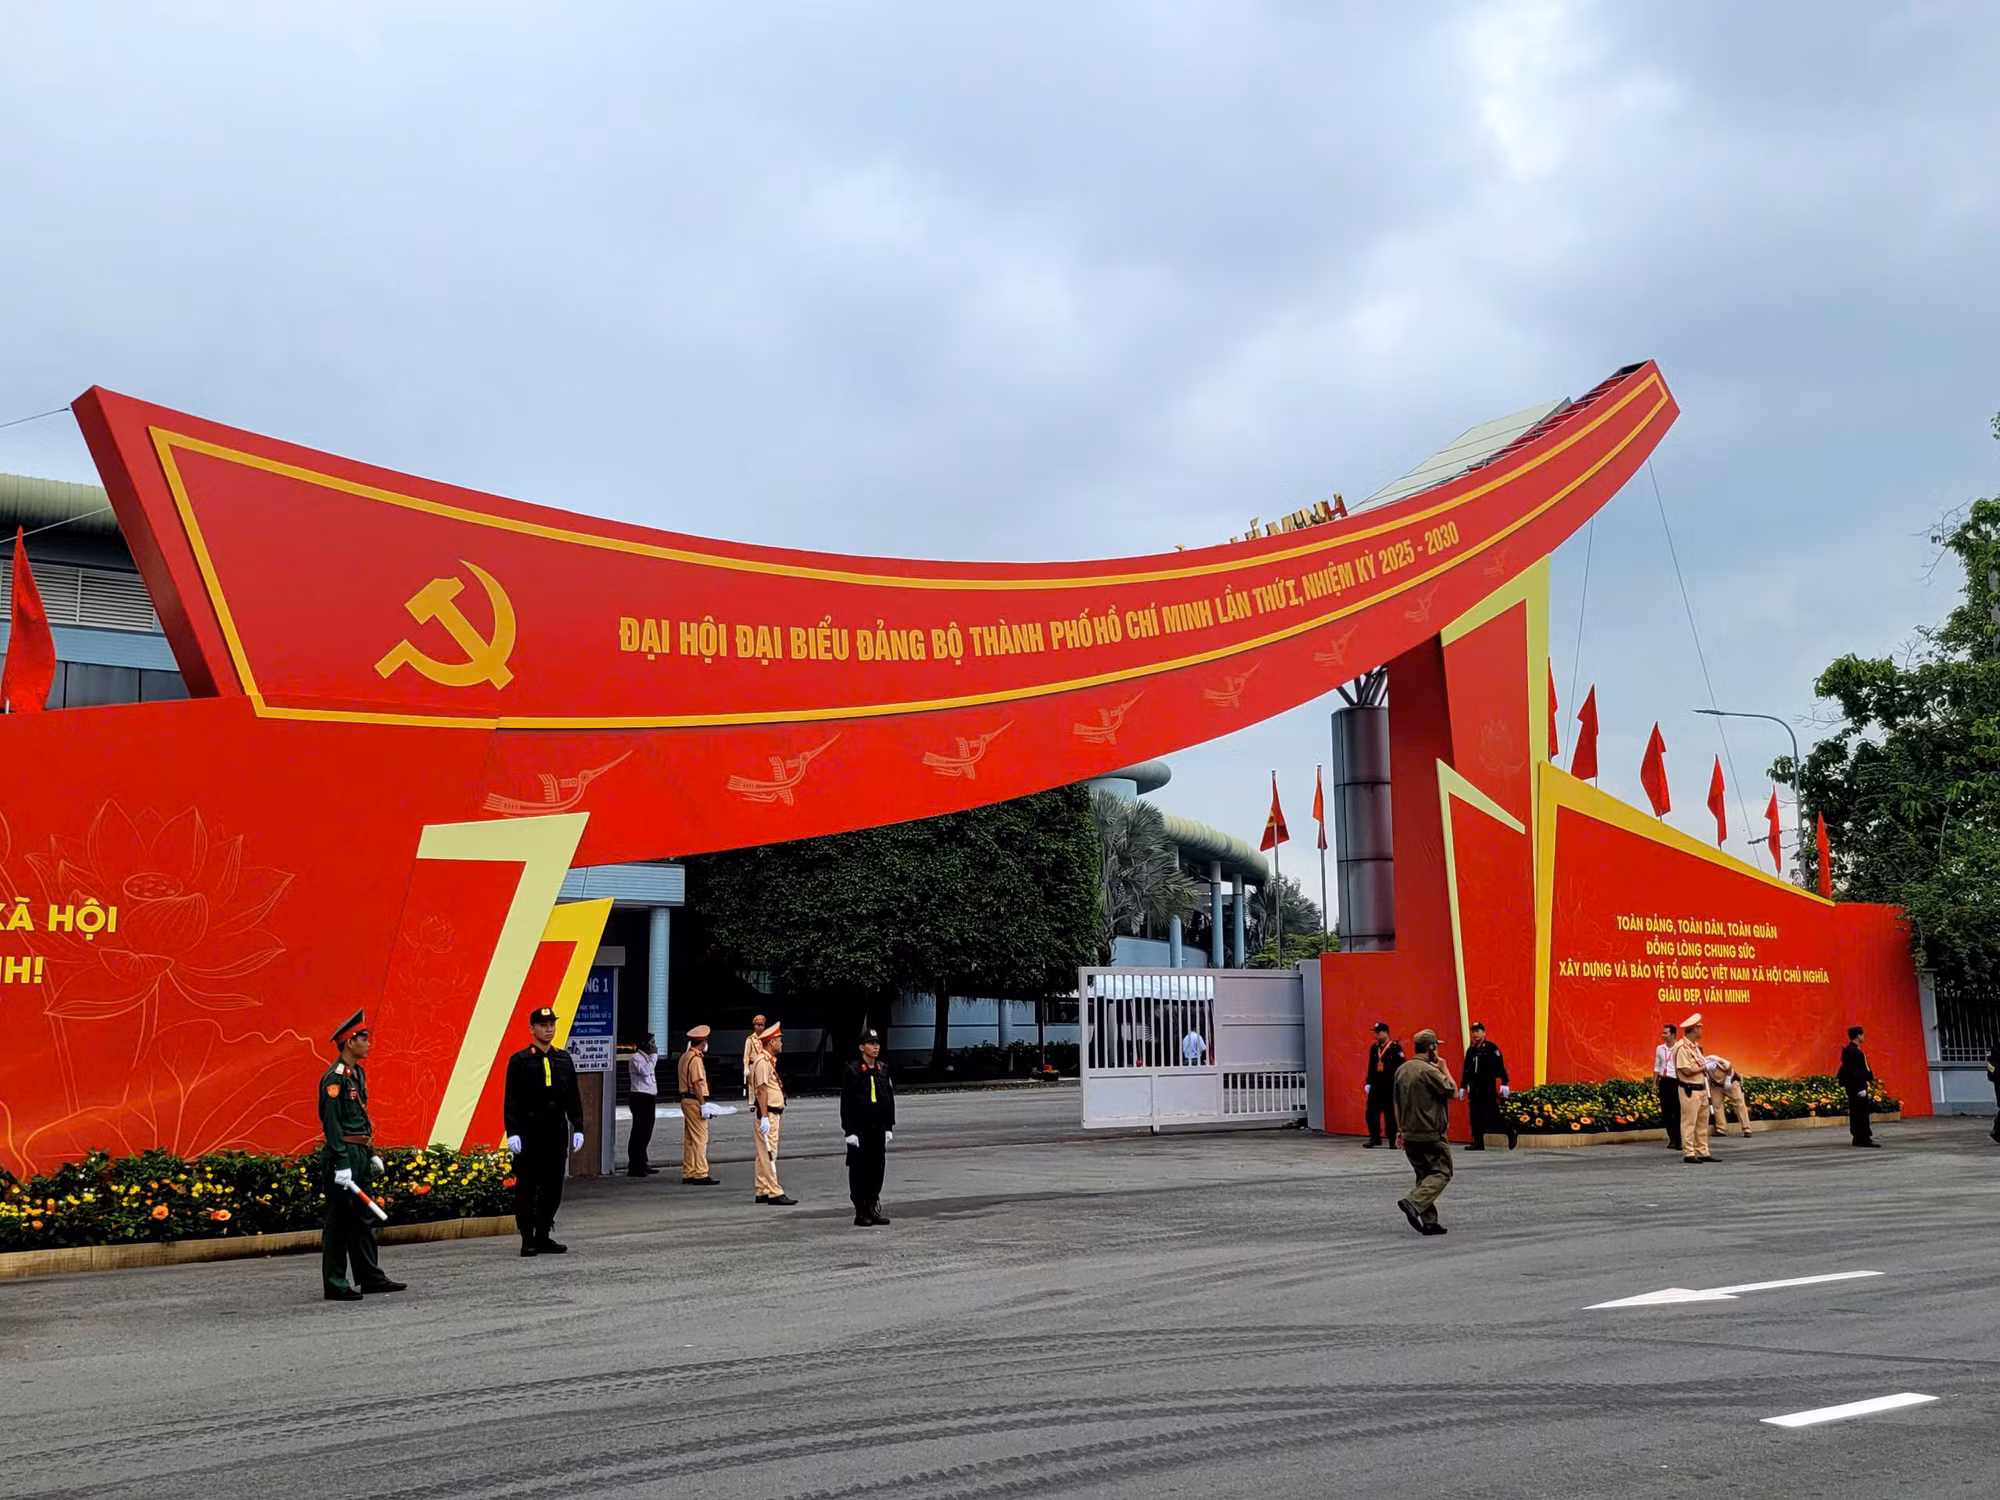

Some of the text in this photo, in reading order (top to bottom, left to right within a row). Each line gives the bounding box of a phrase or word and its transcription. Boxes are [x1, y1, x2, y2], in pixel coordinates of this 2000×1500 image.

[619, 616, 670, 661] ĐẠI
[679, 615, 727, 664] HỘI
[735, 624, 782, 665] ĐẠI
[789, 615, 849, 661] BIỂU
[856, 619, 926, 661] ĐẢNG
[933, 621, 963, 665] BỘ
[969, 619, 1045, 657] THÀNH
[1050, 608, 1093, 650] PHỐ
[1093, 604, 1122, 645] HỒ
[1125, 602, 1160, 640] CHÍ
[1161, 599, 1214, 634] MINH
[1215, 584, 1252, 624] LẦN
[1252, 576, 1286, 614] THỨ
[1301, 561, 1355, 600] NHIỆM
[1355, 549, 1377, 584] KỲ
[1378, 539, 1415, 575] 2025
[1424, 520, 1459, 556] 2030
[48, 898, 118, 940] HỘI
[1617, 913, 1777, 939] TOÀN ĐẢNG, TOÀN DÂN, TOÀN QUÂN
[1646, 935, 1755, 959] ĐỒNG LÒNG CHUNG SỨC
[1559, 957, 1580, 976] XÂY
[1583, 961, 1612, 981] DỰNG
[1614, 959, 1628, 977] VÀ
[1630, 959, 1651, 978] BẢO
[1653, 961, 1665, 982] VỆ
[1666, 958, 1679, 979] TỔ
[1681, 961, 1709, 980] QUỐC
[1710, 963, 1728, 984] VIỆT
[1730, 967, 1750, 980] NAM
[1766, 965, 1782, 986] HỘI
[1783, 965, 1801, 982] CHỦ
[603, 978, 609, 993] 1
[1658, 984, 1751, 1006] GIÀU ĐẸP, VĂN MINH!
